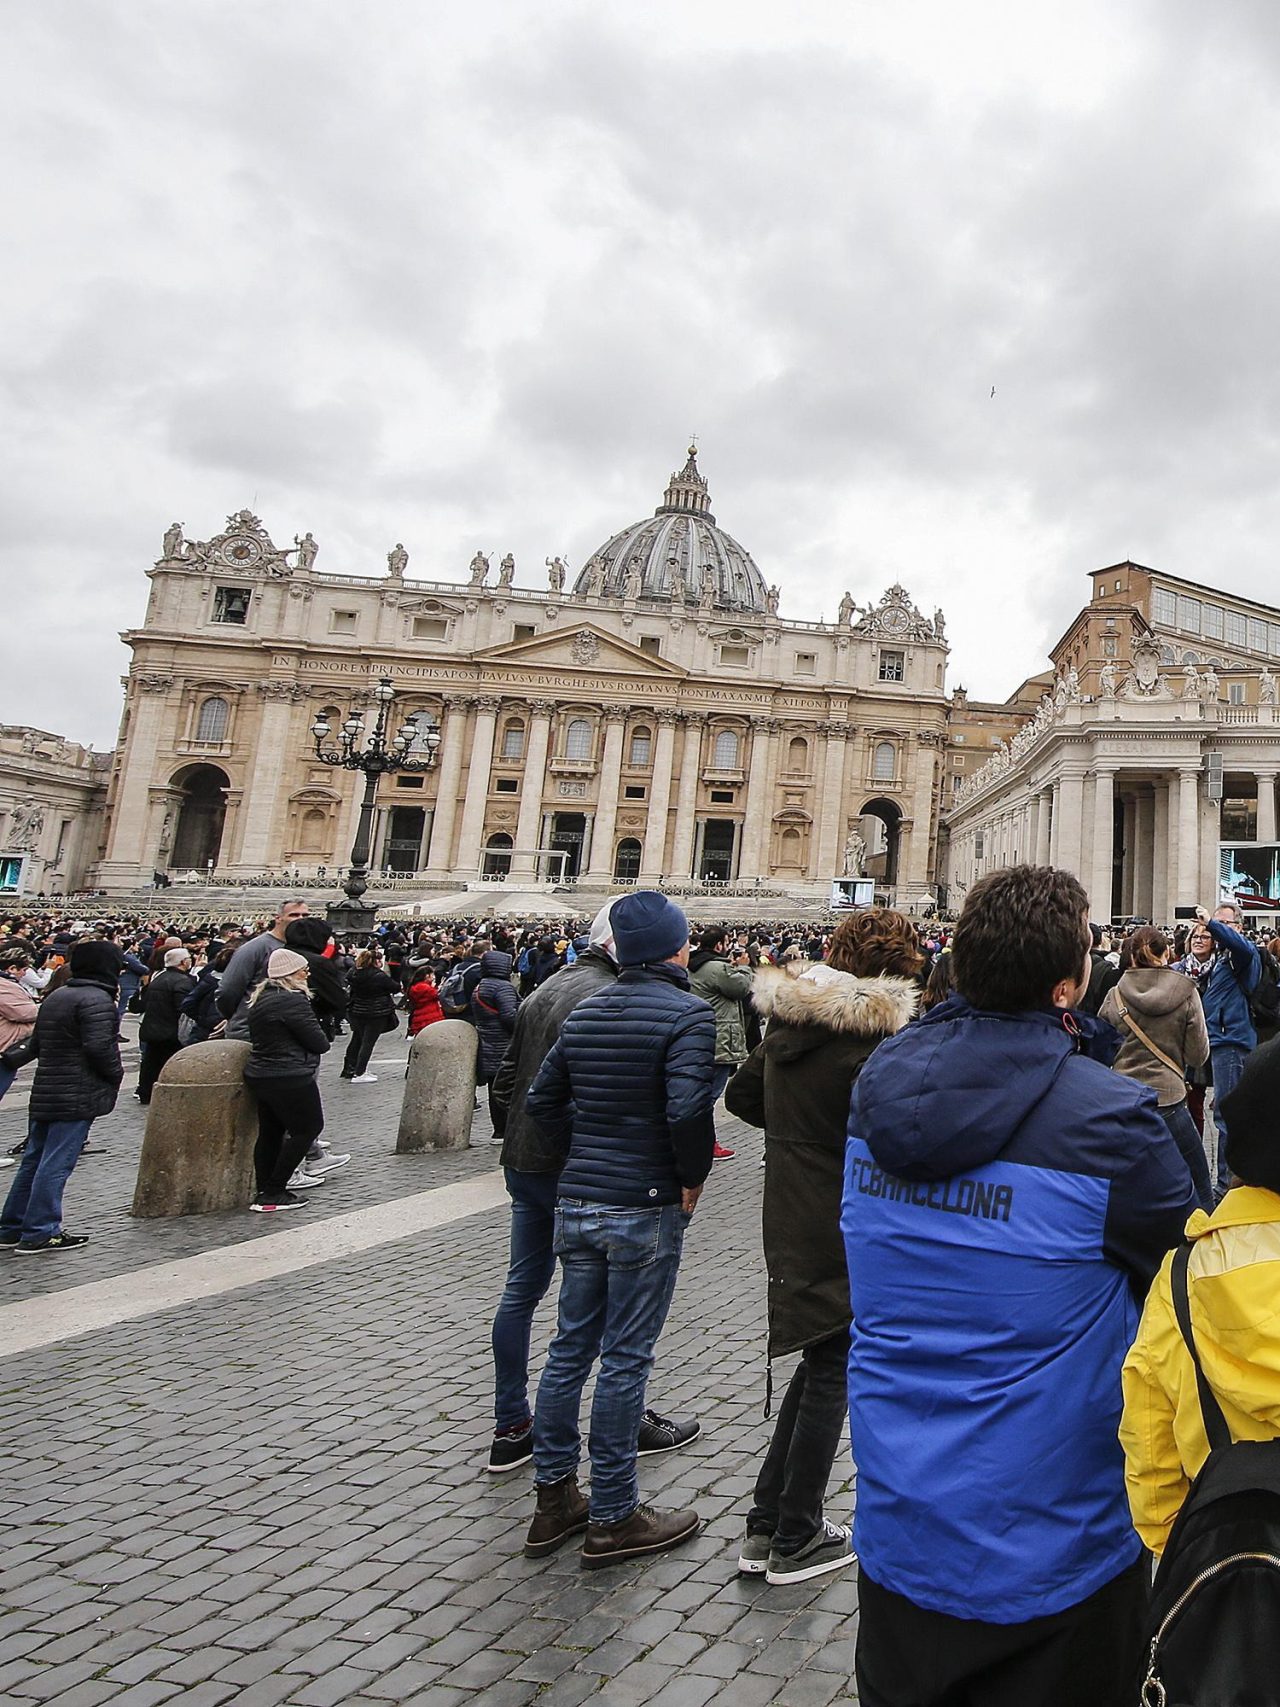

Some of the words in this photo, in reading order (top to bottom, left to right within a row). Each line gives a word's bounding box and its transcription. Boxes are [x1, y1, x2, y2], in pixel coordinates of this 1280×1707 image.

[273, 656, 290, 666] IN
[299, 660, 371, 674] HONOREM
[371, 664, 439, 677] PRINCIPIS
[537, 675, 616, 690] BVRGHESIVS
[617, 682, 678, 694] ROMANVS
[831, 700, 849, 710] VII
